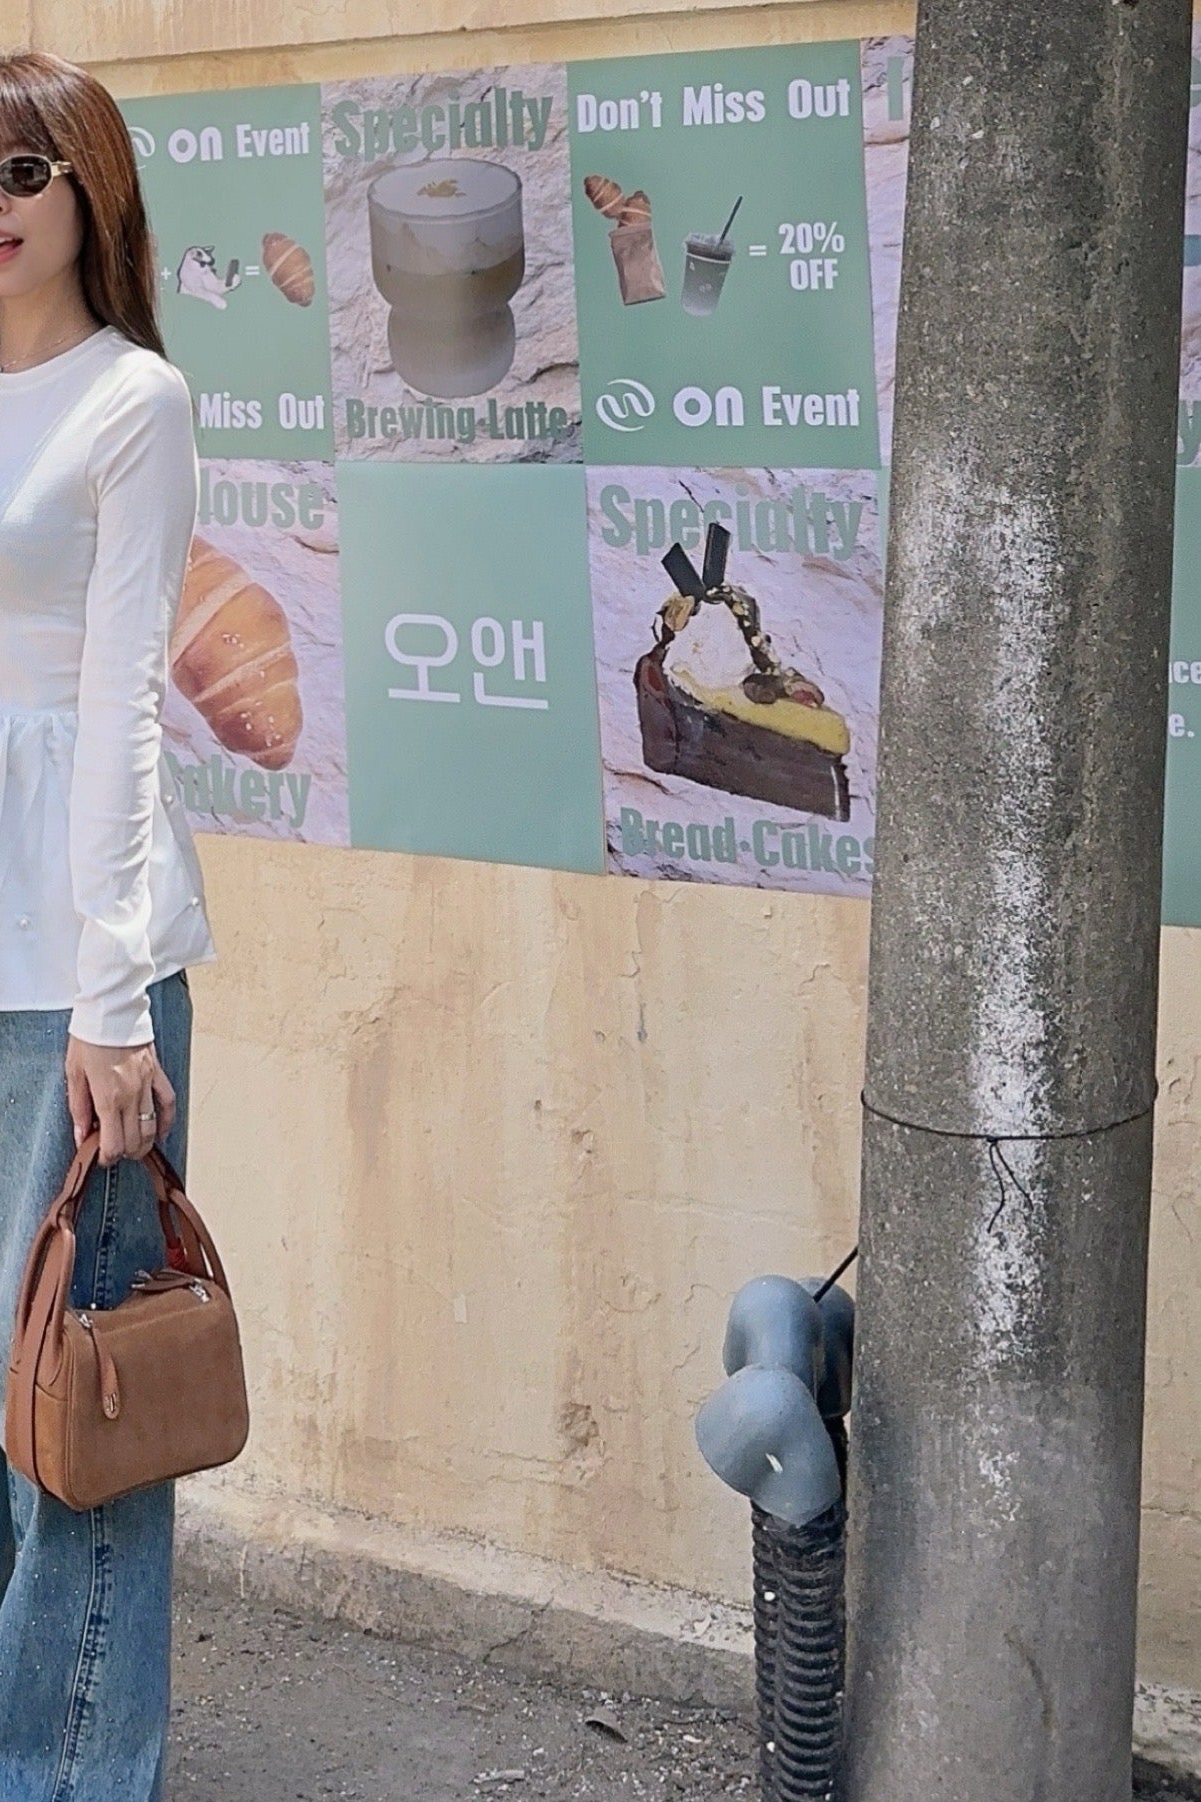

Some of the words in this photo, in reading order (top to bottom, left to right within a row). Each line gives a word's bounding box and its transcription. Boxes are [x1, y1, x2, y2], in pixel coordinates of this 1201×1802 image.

[331, 87, 554, 162] Specialty
[577, 90, 662, 134] Don't
[683, 83, 765, 126] Miss
[788, 78, 850, 119] Out
[236, 121, 310, 158] Event
[778, 222, 845, 254] 20%
[790, 259, 838, 290] OFF
[199, 392, 262, 430] Miss
[279, 393, 325, 430] Out
[763, 385, 860, 426] Event
[385, 613, 549, 710] 오앤
[164, 751, 311, 828] akery
